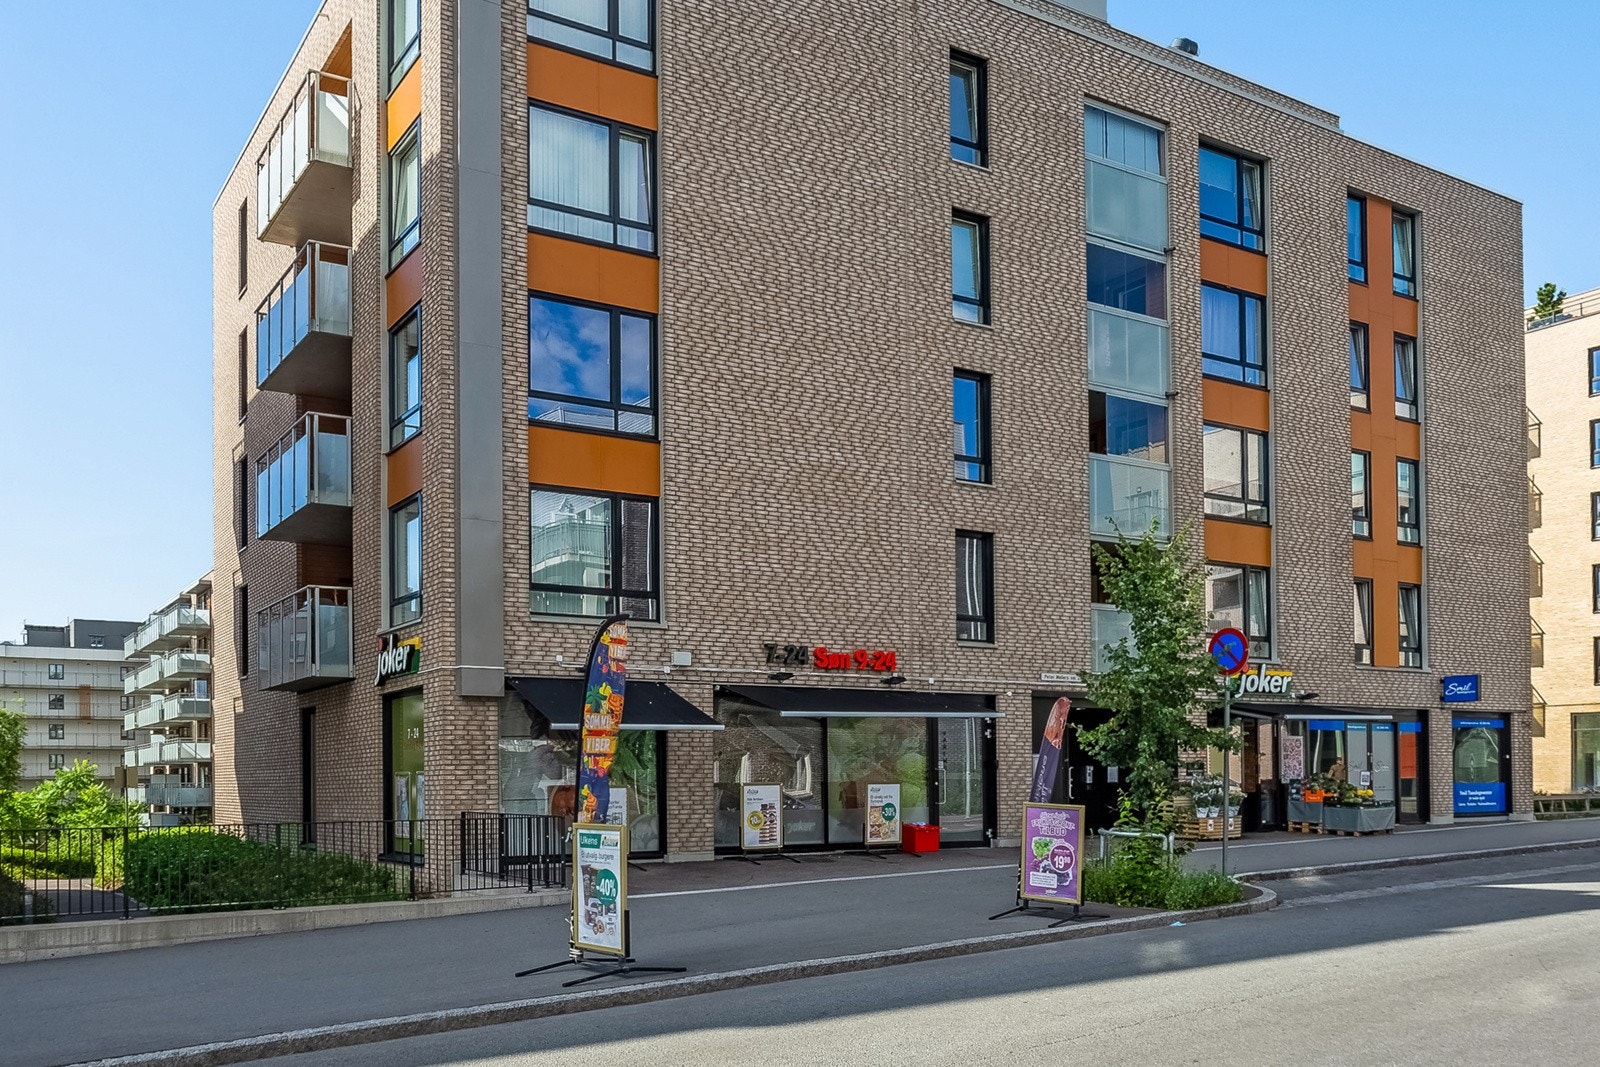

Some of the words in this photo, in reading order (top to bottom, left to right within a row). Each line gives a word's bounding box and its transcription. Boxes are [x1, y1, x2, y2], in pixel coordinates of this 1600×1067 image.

[374, 633, 410, 686] joker
[813, 647, 850, 669] Søn
[1234, 663, 1292, 698] joker
[586, 737, 610, 752] VIBER
[580, 834, 598, 846] Ukens
[596, 878, 616, 897] -40%
